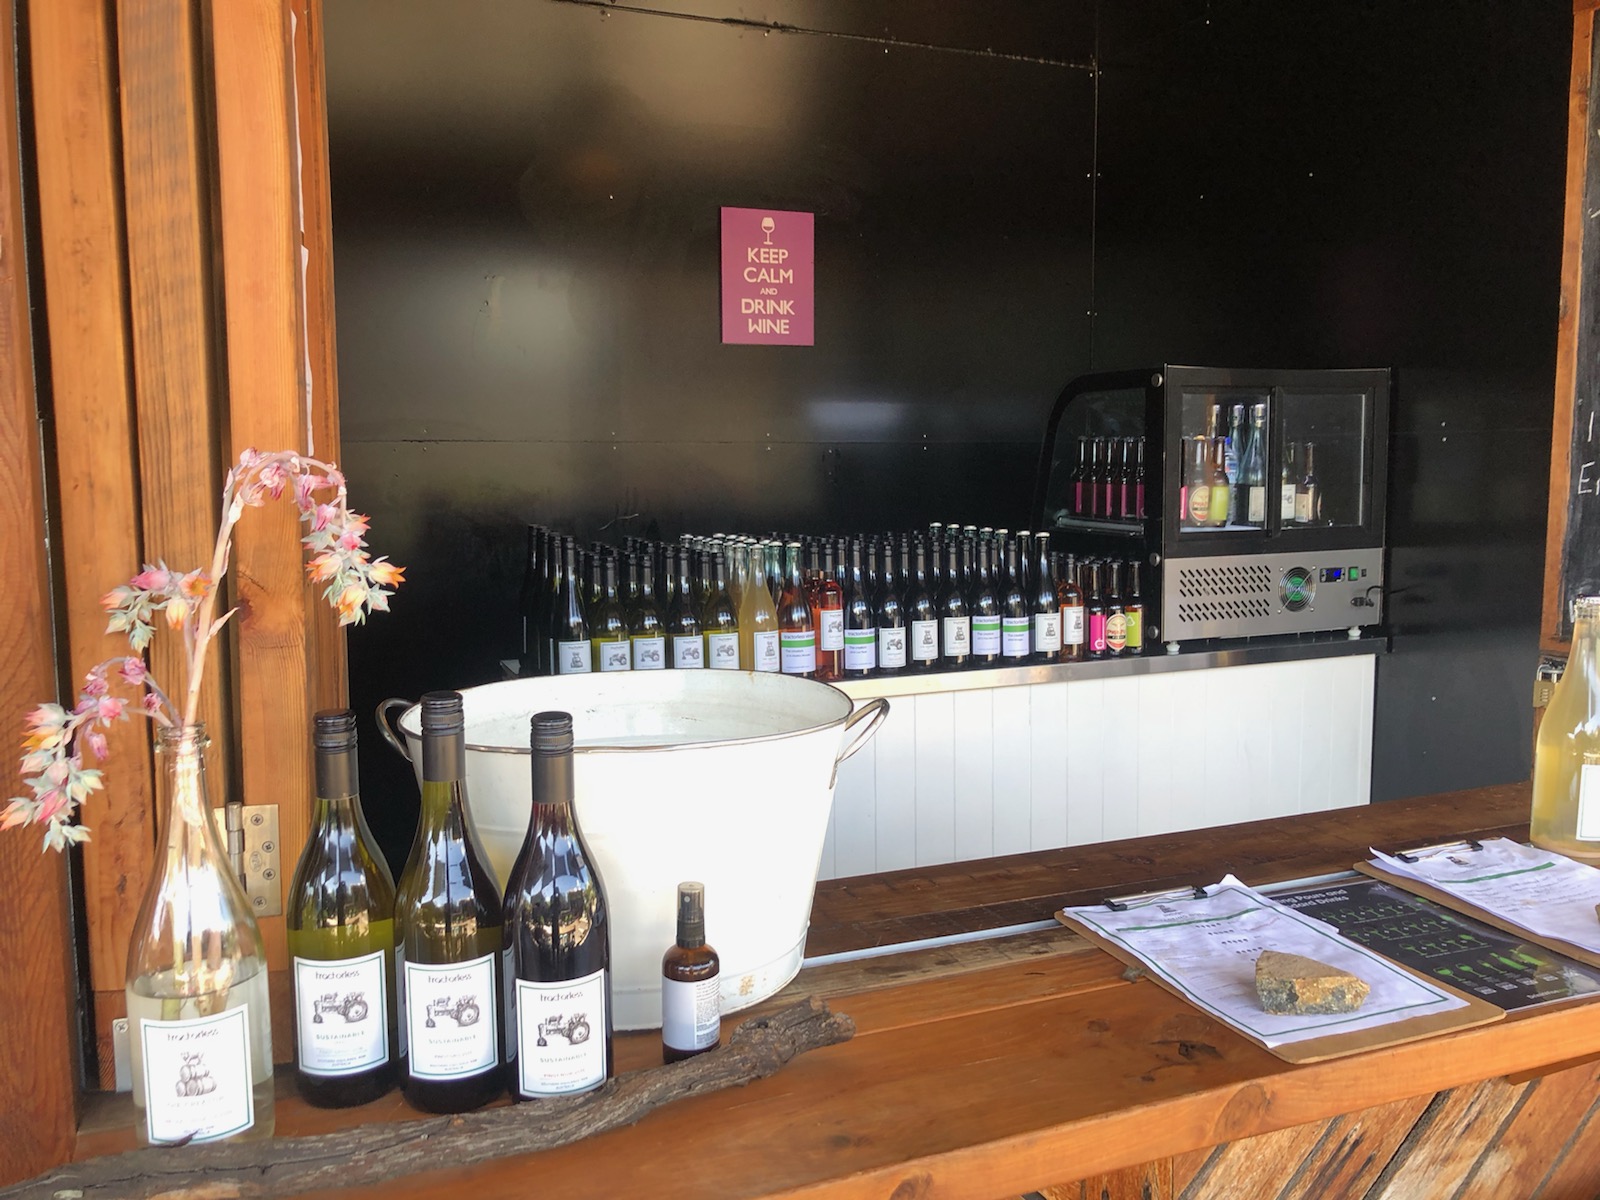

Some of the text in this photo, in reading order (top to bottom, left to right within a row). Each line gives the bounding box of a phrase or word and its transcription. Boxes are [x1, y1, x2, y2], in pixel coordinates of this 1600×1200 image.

[747, 247, 789, 264] KEEP
[743, 267, 793, 284] CALM
[759, 287, 778, 296] AND
[741, 298, 795, 316] DRINK
[748, 318, 790, 335] WINE
[1315, 895, 1350, 905] Drinks
[1326, 888, 1348, 897] and
